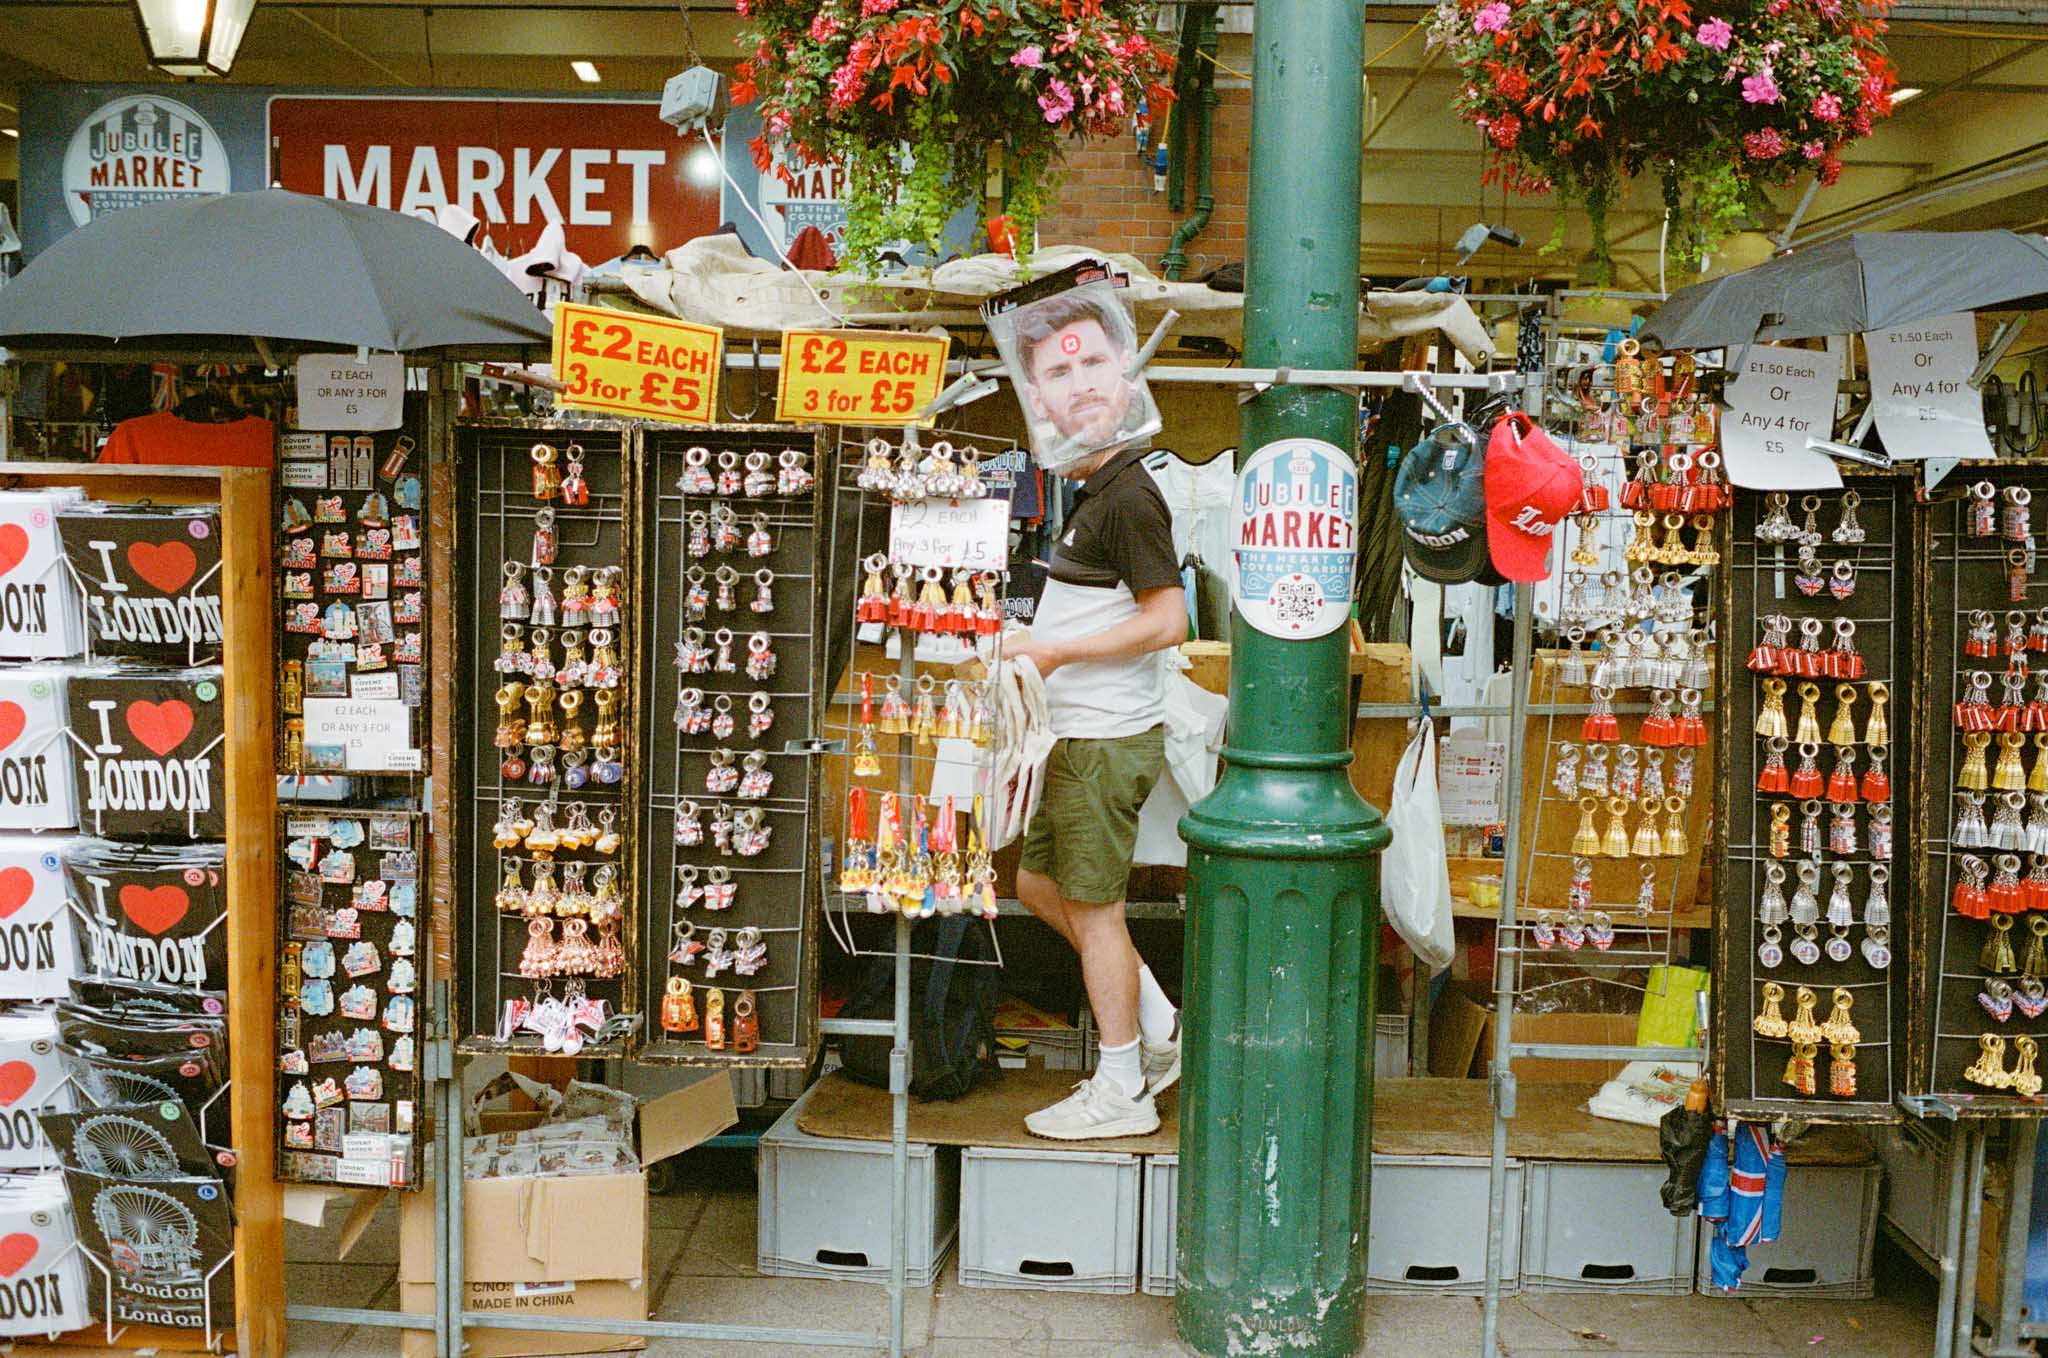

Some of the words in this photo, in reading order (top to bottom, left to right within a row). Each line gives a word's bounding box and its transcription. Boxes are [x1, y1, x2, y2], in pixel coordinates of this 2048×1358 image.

[90, 131, 201, 162] JUBILEE
[91, 156, 202, 188] MARKET
[324, 144, 666, 226] MARKET
[788, 213, 841, 221] COVENT
[807, 204, 832, 213] THE
[569, 319, 634, 362] £2
[637, 341, 709, 374] EACH
[1889, 332, 1922, 344] £1.50
[1924, 331, 1954, 342] Each
[801, 338, 848, 374] £2
[858, 350, 930, 376] EACH
[1913, 352, 1935, 368] Or
[330, 370, 342, 380] £2
[345, 370, 374, 380] EACH
[1750, 362, 1784, 376] £1.50
[1786, 366, 1816, 379] Each
[317, 387, 332, 398] OR
[334, 387, 355, 398] ANY
[357, 388, 364, 398] 3
[366, 388, 388, 398] FOR
[567, 362, 588, 396] 3
[591, 380, 632, 402] for
[639, 372, 701, 412] £5
[803, 389, 819, 412] 3
[828, 389, 863, 412] for
[869, 379, 916, 414] £5
[1769, 385, 1791, 402] Or
[1892, 382, 1922, 398] Any
[1924, 382, 1935, 395] 4
[1938, 379, 1961, 394] for
[345, 404, 358, 415] £5
[1741, 411, 1772, 430] Any
[1774, 415, 1785, 430] 4
[1789, 417, 1811, 432] for
[1765, 440, 1784, 454] £5
[1243, 481, 1353, 518] JUBILEE
[898, 500, 930, 529] £2
[937, 510, 978, 526] EACH
[1241, 510, 1353, 549] MARKET
[920, 540, 929, 552] 3
[88, 540, 128, 592] I
[1241, 562, 1294, 573] COVENT
[1242, 552, 1267, 562] THE
[1278, 554, 1329, 564] HEART
[0, 582, 47, 634] ON
[89, 595, 224, 643] LONDON
[335, 705, 347, 716] £2
[350, 705, 377, 716] EACH
[88, 700, 122, 754] I
[321, 722, 336, 732] OR
[338, 722, 361, 732] ANY
[370, 722, 391, 733] FOR
[0, 756, 48, 805] ON
[84, 758, 211, 811] LONDON
[86, 923, 208, 983] LONDON
[119, 1276, 206, 1300] London
[472, 1281, 511, 1293] C/NO:
[472, 1297, 512, 1310] MADE
[515, 1296, 529, 1309] IN
[532, 1294, 575, 1308] CHINA
[118, 1305, 204, 1327] London
